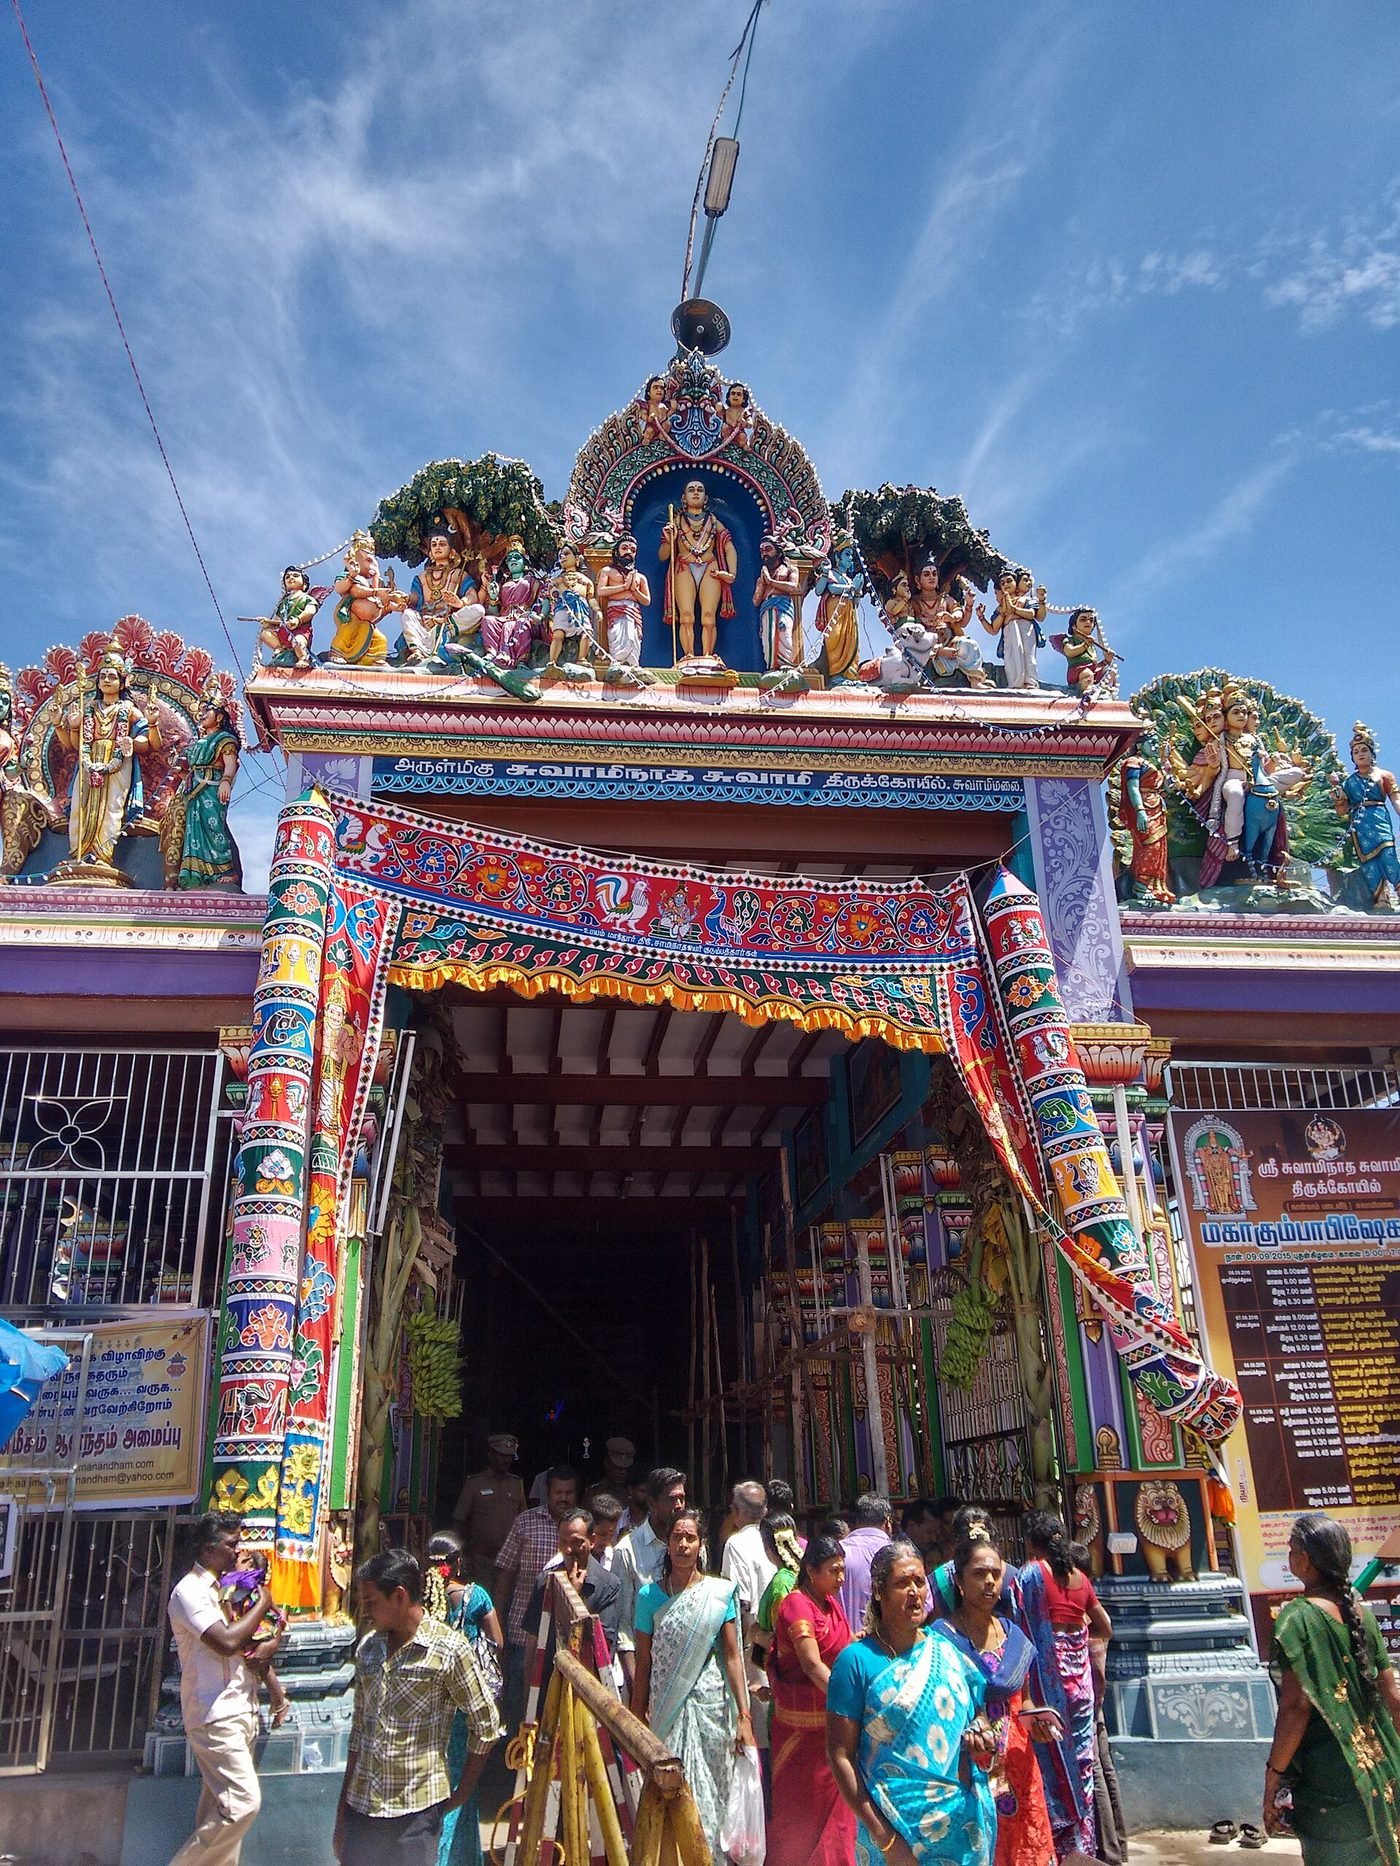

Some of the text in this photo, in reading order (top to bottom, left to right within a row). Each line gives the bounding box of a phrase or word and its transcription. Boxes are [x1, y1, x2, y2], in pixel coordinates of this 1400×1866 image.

[394, 758, 494, 776] அருள்மிகு
[506, 764, 694, 783] சுவாமிநாத
[702, 770, 814, 786] சுவாமி
[1282, 1160, 1356, 1176] சுவாமிநாத
[1292, 1179, 1381, 1198] திருக்கோயில்
[101, 1348, 165, 1364] விழாவிற்கு
[122, 1421, 182, 1450] அமைப்பு
[78, 1461, 154, 1472] manandham.com
